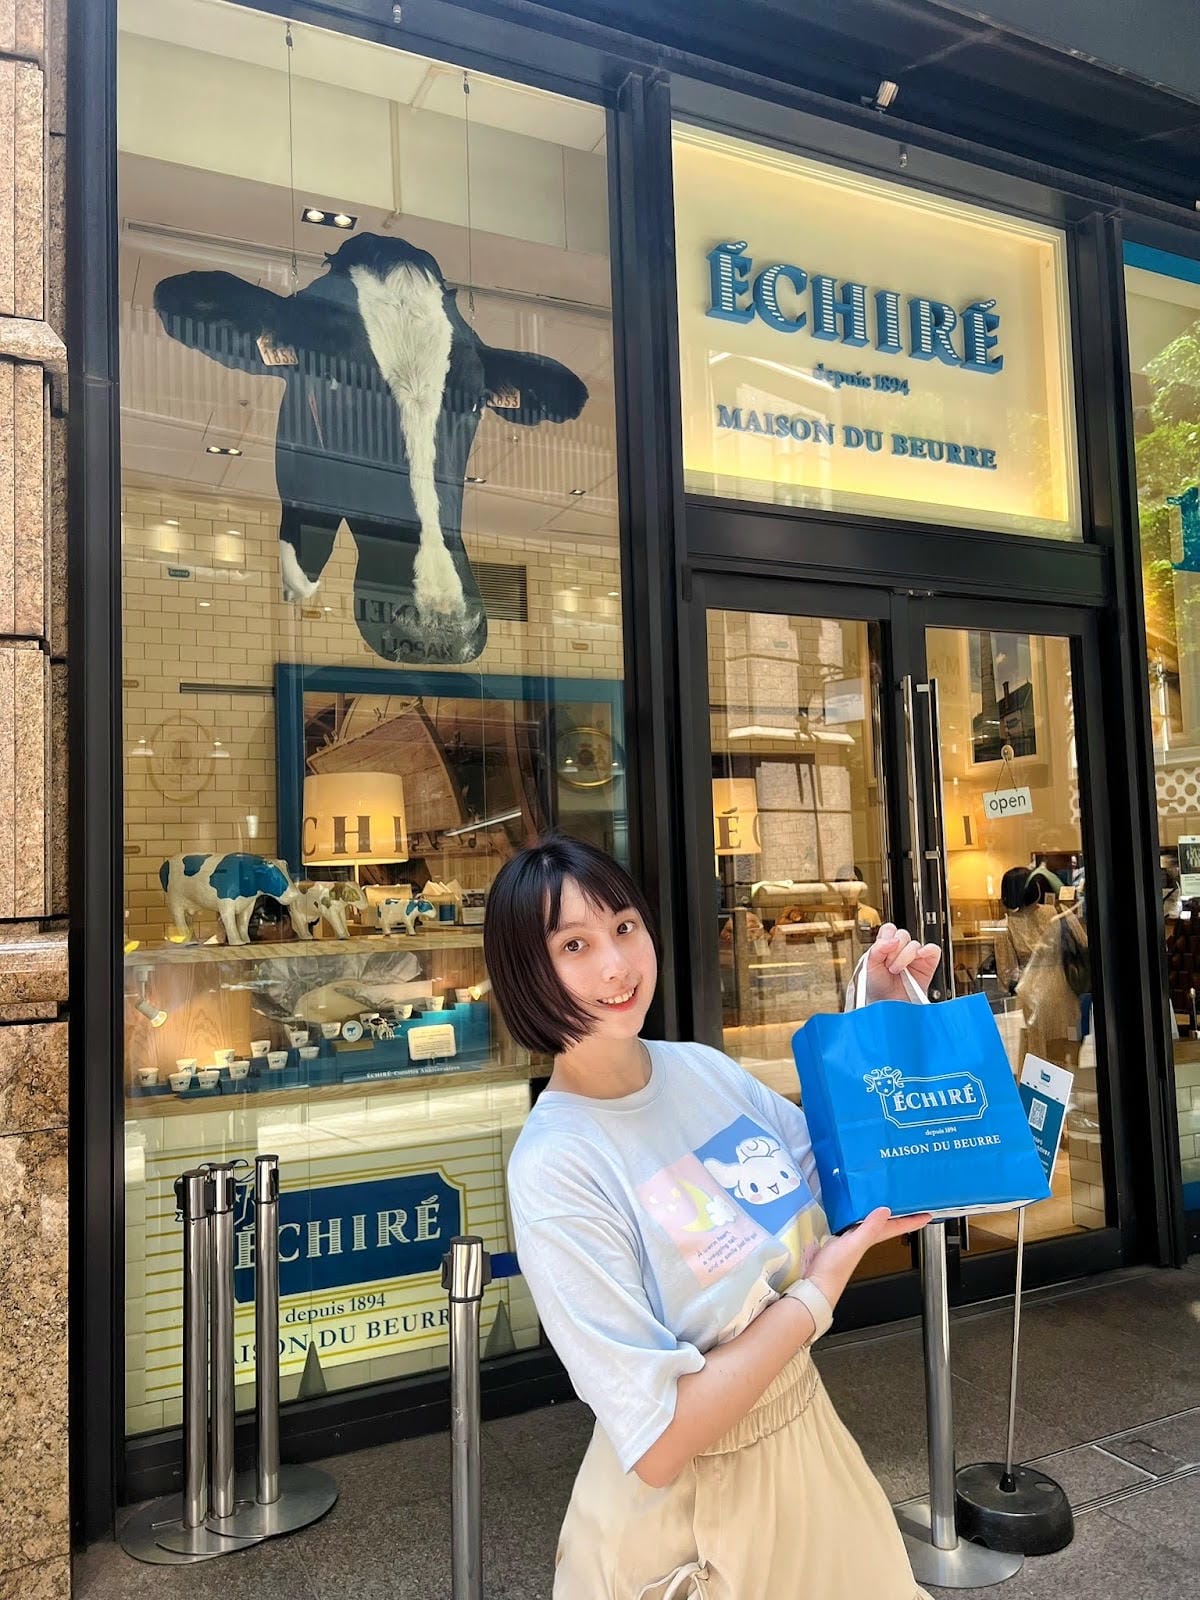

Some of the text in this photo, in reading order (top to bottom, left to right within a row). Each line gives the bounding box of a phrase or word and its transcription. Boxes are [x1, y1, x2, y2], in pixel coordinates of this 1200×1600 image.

[705, 240, 1004, 376] ÉCHIRÉ
[813, 363, 911, 397] depuis 1894
[716, 404, 998, 471] MAISON DU BEURRE
[989, 795, 1027, 814] open
[893, 1084, 977, 1113] ÉCHIRÉ
[880, 1134, 1002, 1159] MAISON DU BEURRE
[925, 1126, 957, 1137] depuis 1894
[233, 1194, 441, 1270] ÉCHIRÉ
[285, 1292, 387, 1326] depuis 1894
[319, 1308, 450, 1349] DU BEURR
